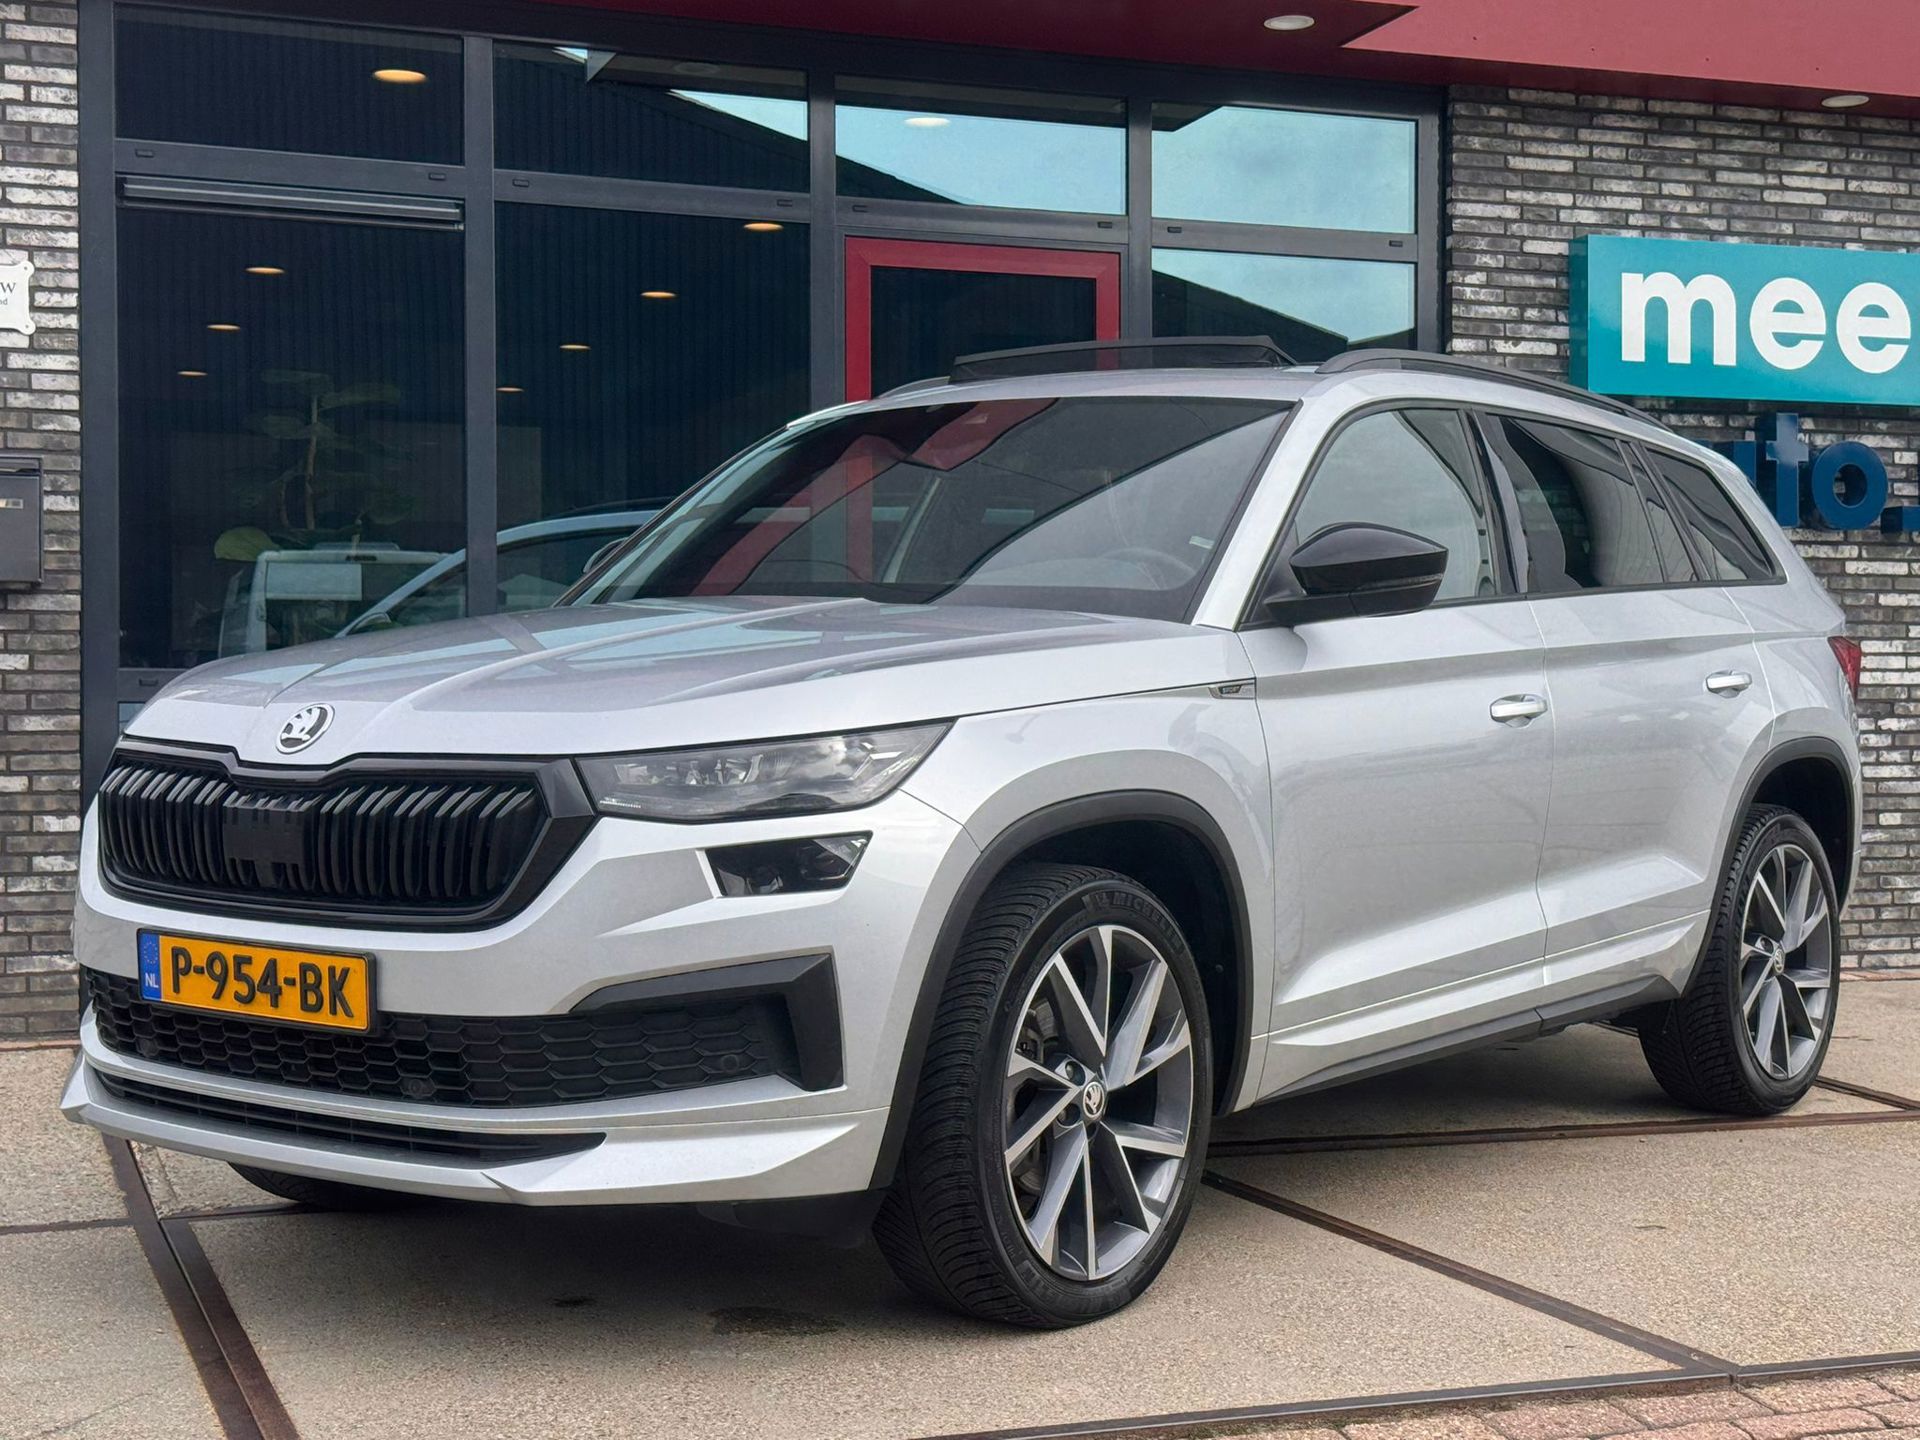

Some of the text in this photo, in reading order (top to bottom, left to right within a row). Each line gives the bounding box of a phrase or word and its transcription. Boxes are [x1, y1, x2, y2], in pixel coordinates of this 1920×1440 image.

[1621, 271, 1911, 374] mee
[145, 972, 159, 989] NL
[171, 946, 354, 1018] P-954-BK
